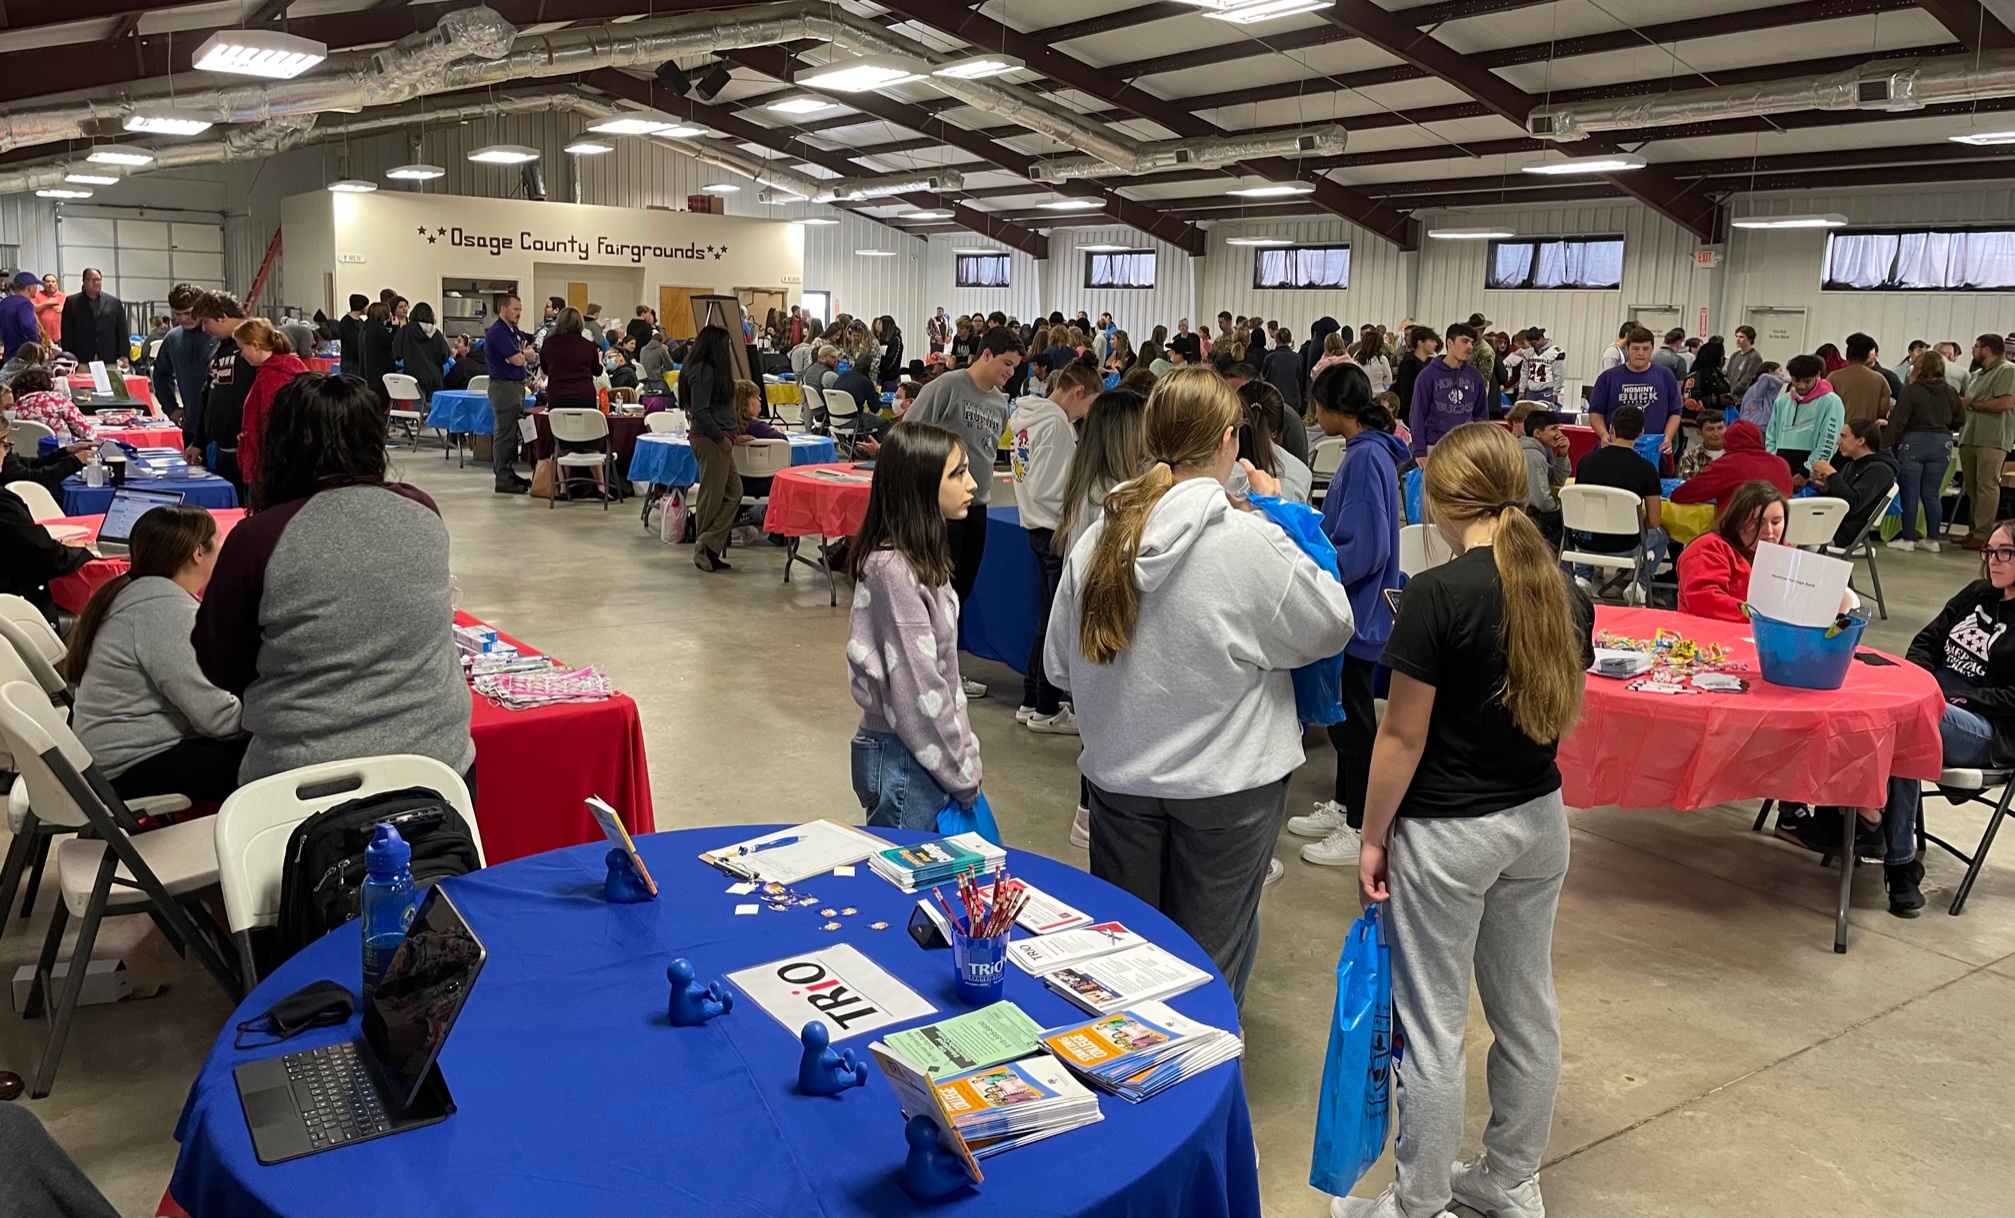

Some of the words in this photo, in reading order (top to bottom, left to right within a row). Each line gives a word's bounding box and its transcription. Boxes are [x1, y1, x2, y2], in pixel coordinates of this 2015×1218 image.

[451, 227, 513, 256] Osage
[520, 231, 589, 260] County
[597, 236, 705, 263] Fairgrounds
[1698, 251, 1712, 263] EXIT
[1434, 377, 1475, 392] HOMINY
[1618, 392, 1658, 402] BUCK
[1434, 400, 1474, 414] BUCKS
[968, 960, 1004, 976] TRiO
[1068, 1033, 1108, 1058] COLLEGE
[938, 1086, 972, 1110] COLLEGE
